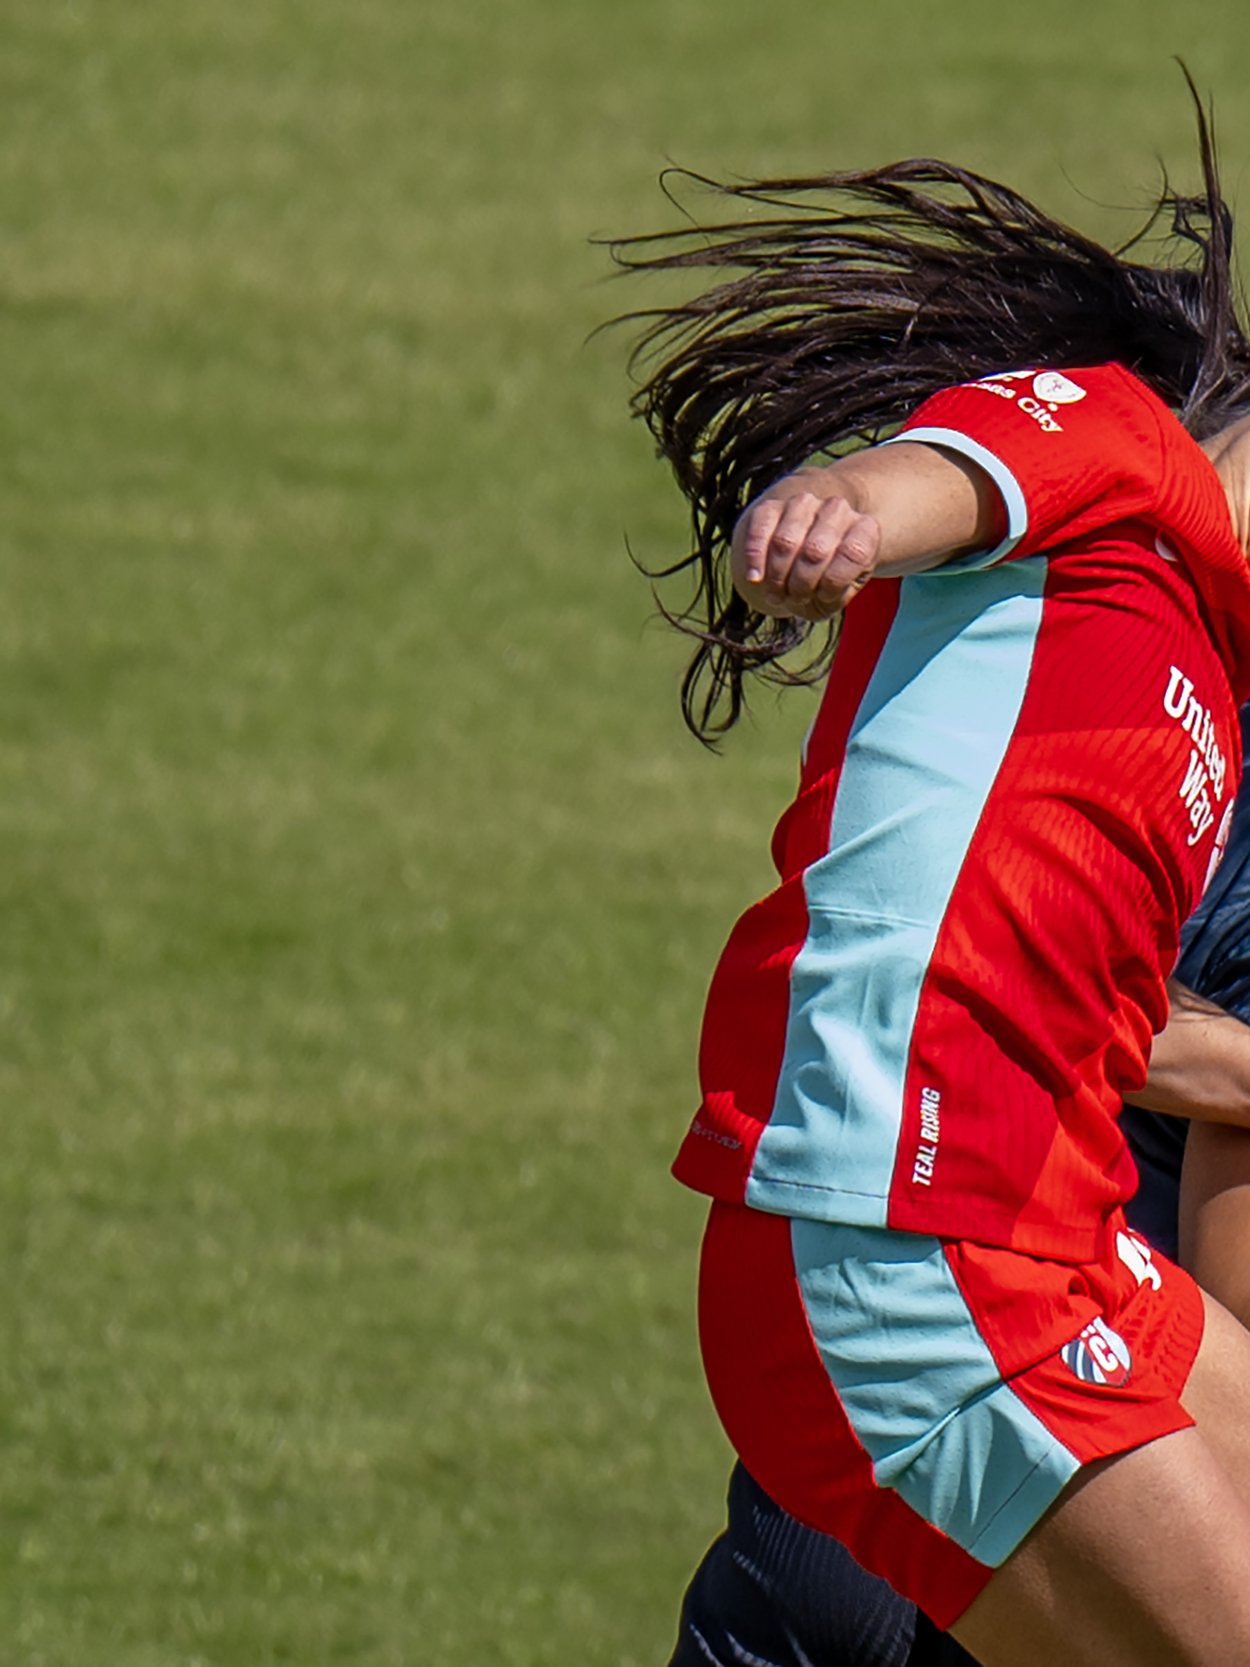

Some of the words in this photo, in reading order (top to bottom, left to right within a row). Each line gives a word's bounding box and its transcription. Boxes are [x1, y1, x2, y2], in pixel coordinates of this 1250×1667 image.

[1017, 396, 1063, 432] City
[1178, 749, 1215, 847] Way
[919, 1086, 943, 1144] RISING
[910, 1144, 938, 1188] TEAL
